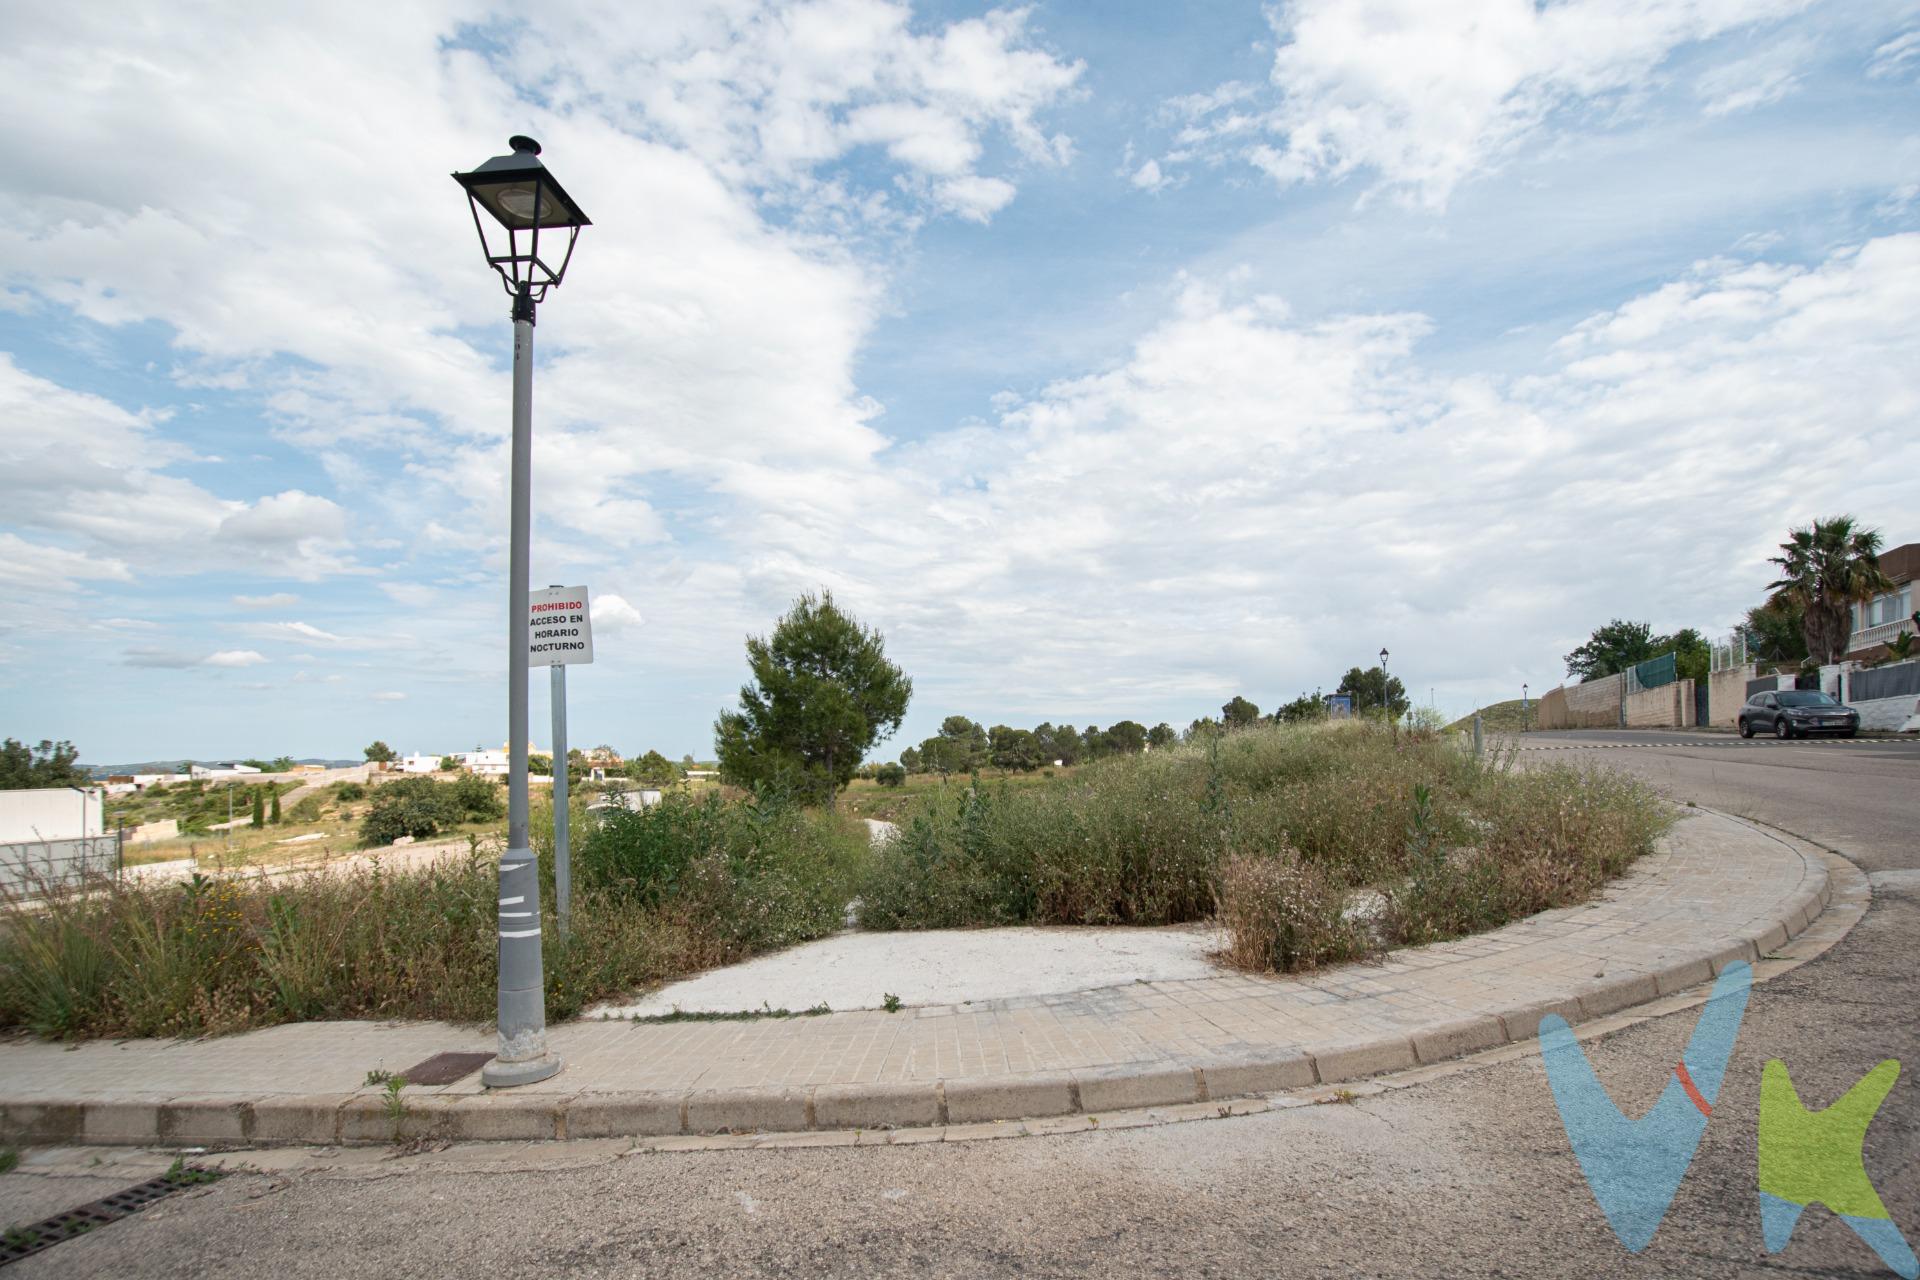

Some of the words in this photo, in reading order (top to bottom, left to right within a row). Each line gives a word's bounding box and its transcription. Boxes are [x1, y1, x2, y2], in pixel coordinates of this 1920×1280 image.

[531, 601, 582, 613] PROHIBIDO
[530, 615, 566, 626] ACCESO
[569, 614, 583, 623] EN
[535, 628, 579, 639] HORARIO
[530, 642, 585, 653] NOCTURNO
